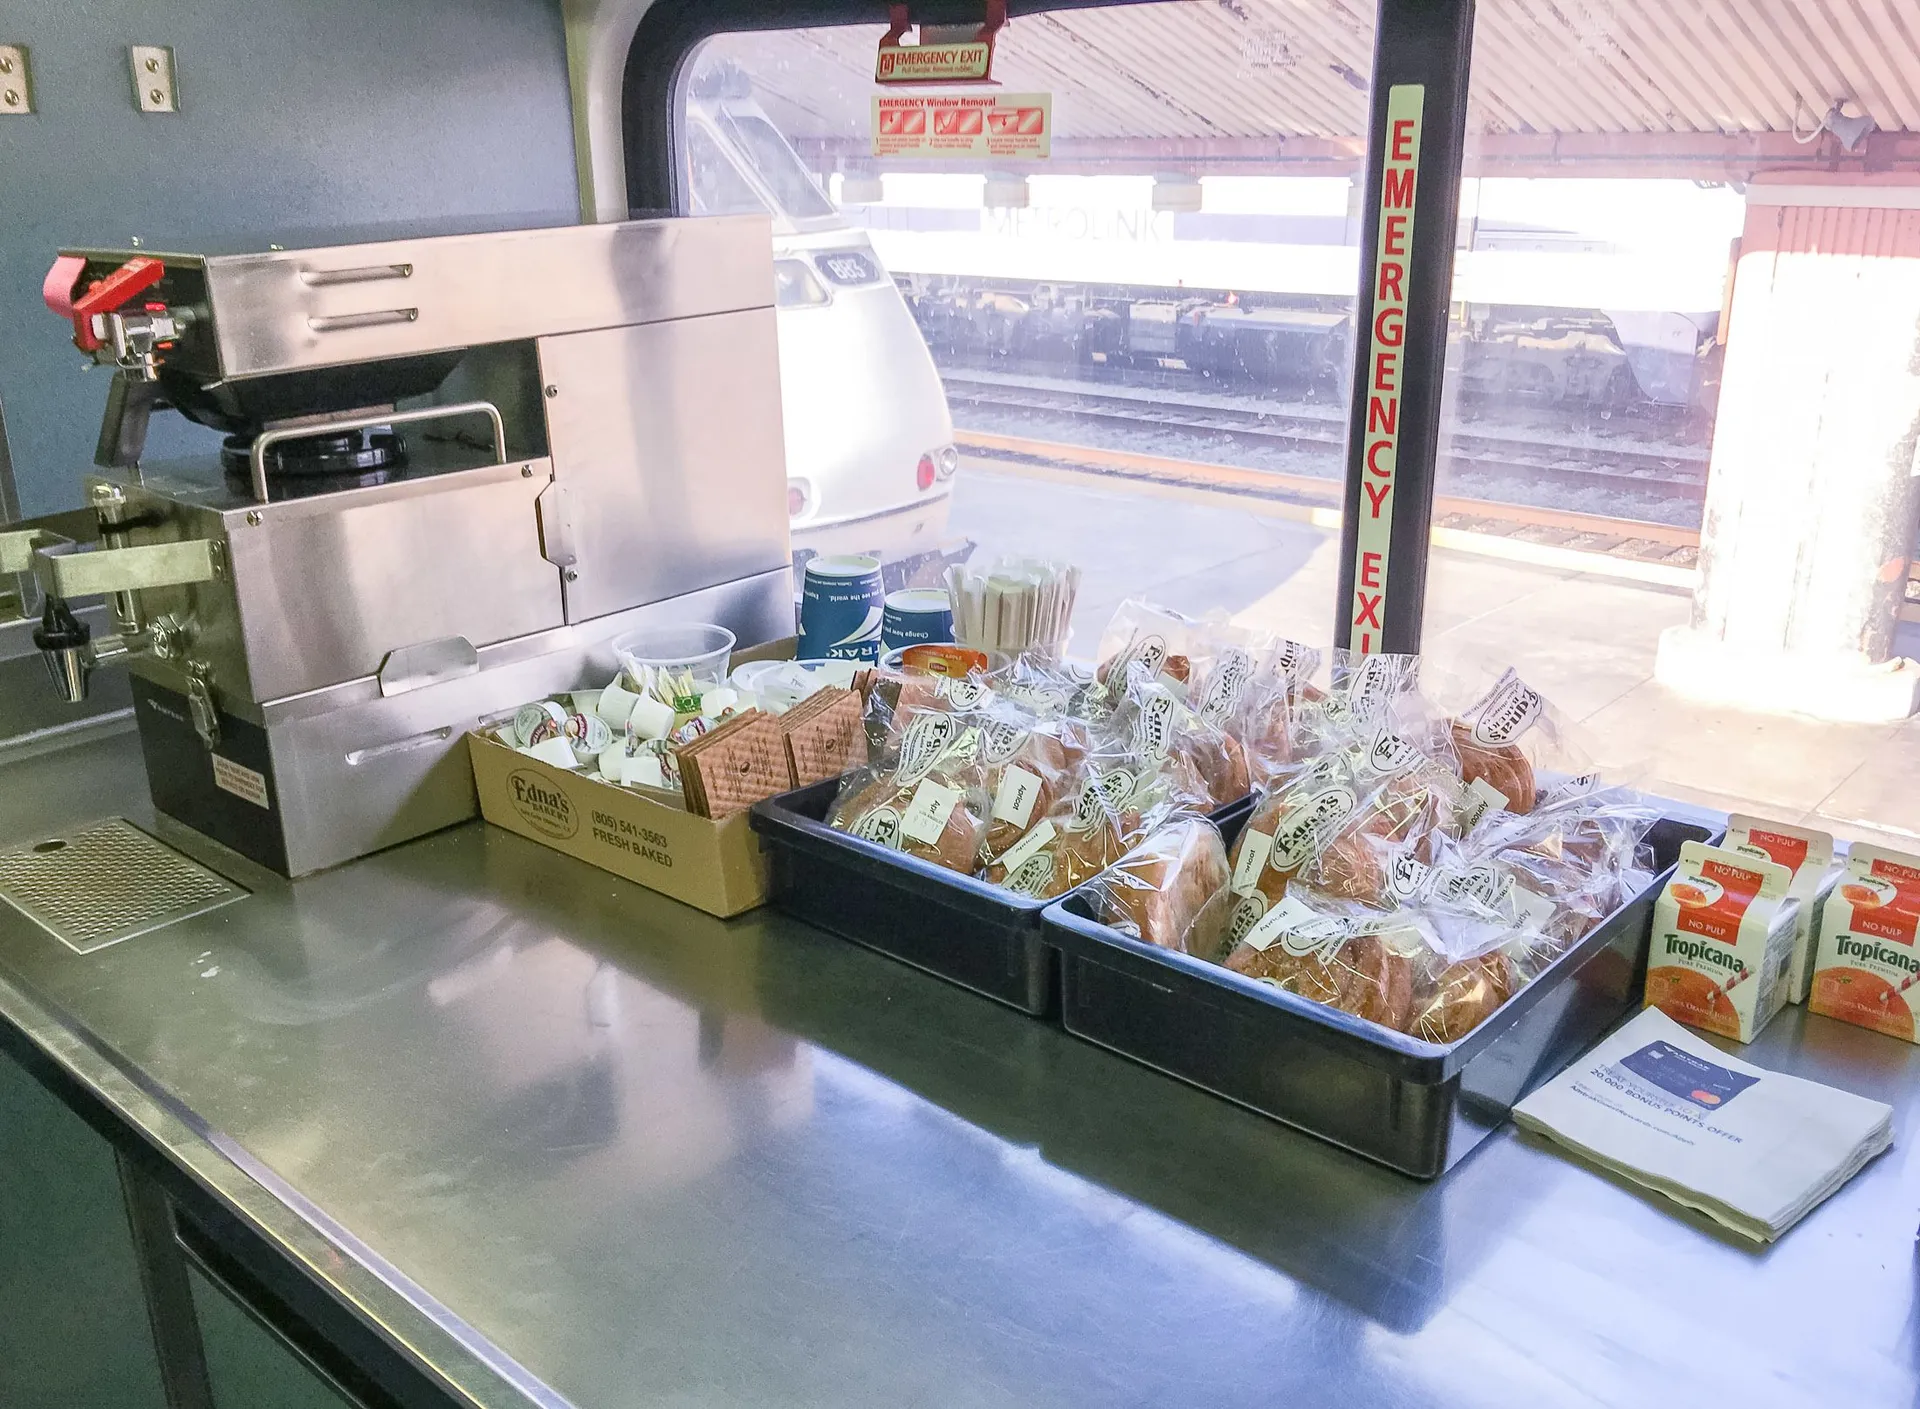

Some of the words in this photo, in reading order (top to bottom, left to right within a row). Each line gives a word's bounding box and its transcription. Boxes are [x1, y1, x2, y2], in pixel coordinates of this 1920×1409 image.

[896, 50, 958, 65] EMERGENCY
[960, 48, 984, 63] EXIT
[879, 98, 924, 108] EMERGENCY
[927, 97, 959, 107] Window
[960, 96, 996, 107] Removal
[1363, 119, 1416, 519] EMERGENCY
[1353, 551, 1383, 654] EXI
[1487, 696, 1520, 732] BAKERY
[1489, 686, 1539, 741] Edna's
[511, 775, 570, 815] Edna's
[1013, 784, 1027, 811] Apricot
[531, 803, 570, 824] BAKERY
[1276, 795, 1339, 857] Edna's
[1470, 800, 1489, 827] Apricot
[591, 809, 618, 832] (805)
[619, 821, 668, 848] 541-3563
[1760, 833, 1775, 843] NO
[1776, 836, 1797, 848] PULP
[592, 827, 631, 851] FRESH
[631, 842, 673, 868] BAKED
[1713, 865, 1729, 876] NO
[1731, 866, 1753, 881] PULP
[1883, 864, 1900, 874] NO
[1687, 918, 1704, 930] NO
[1705, 923, 1726, 936] PULP
[1861, 920, 1879, 931] NO
[1880, 924, 1903, 937] PULP
[1664, 933, 1744, 973] Tropicana
[1677, 957, 1694, 968] PURE
[1695, 960, 1724, 976] PREMIUM
[1835, 935, 1920, 974] Tropicana
[1850, 960, 1867, 969] PURE
[1869, 963, 1899, 978] PREMIUM
[1685, 1001, 1713, 1016] ORANGE
[1714, 1010, 1733, 1022] JUICE
[1598, 1063, 1628, 1082] TREAT
[1624, 1088, 1662, 1110] BONUS
[1663, 1107, 1705, 1128] POINTS
[1706, 1125, 1744, 1143] OFFER
